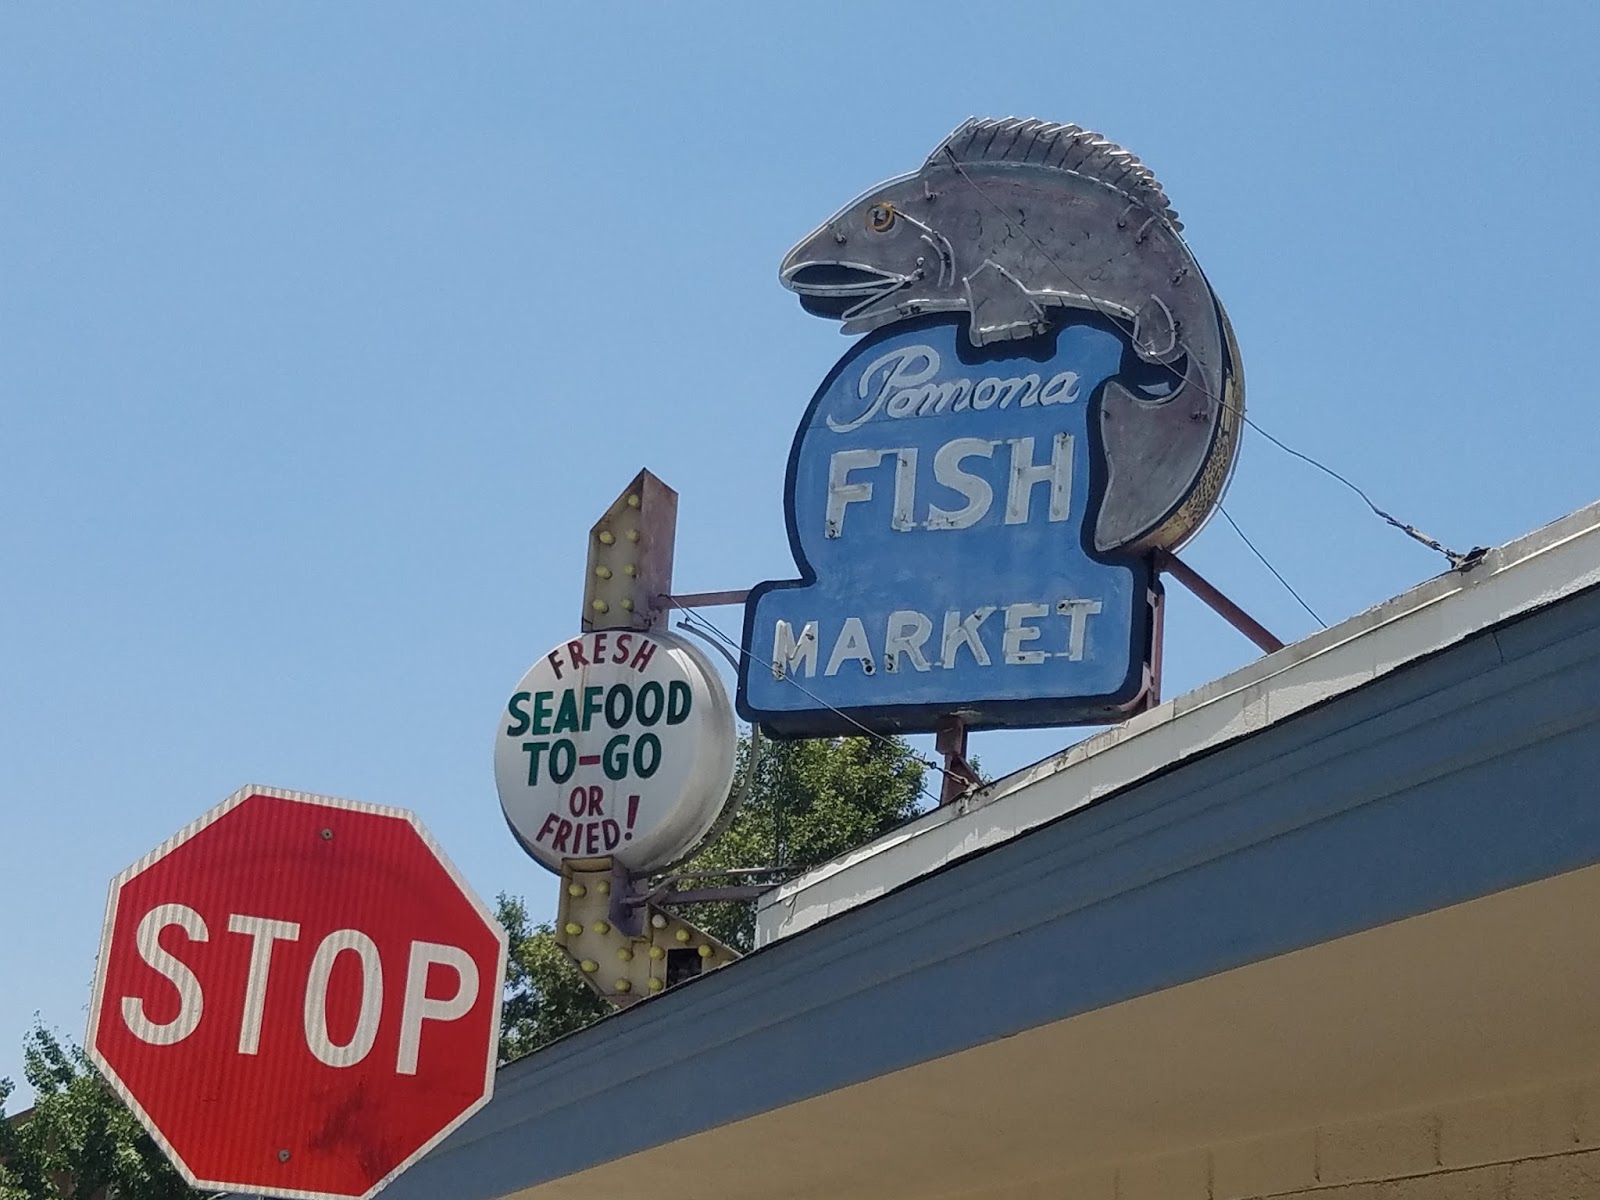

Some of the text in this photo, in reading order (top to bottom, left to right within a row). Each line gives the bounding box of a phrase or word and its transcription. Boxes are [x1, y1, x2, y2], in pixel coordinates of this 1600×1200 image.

[826, 344, 1081, 433] Pomona
[825, 433, 1075, 539] FISH
[548, 633, 657, 680] FRESH
[772, 600, 1102, 680] MARKET
[507, 680, 692, 737] SEAFOOD
[522, 733, 662, 786] TO-GO
[536, 795, 640, 855] FRIED!
[569, 785, 604, 818] OR
[121, 903, 480, 1075] STOP
